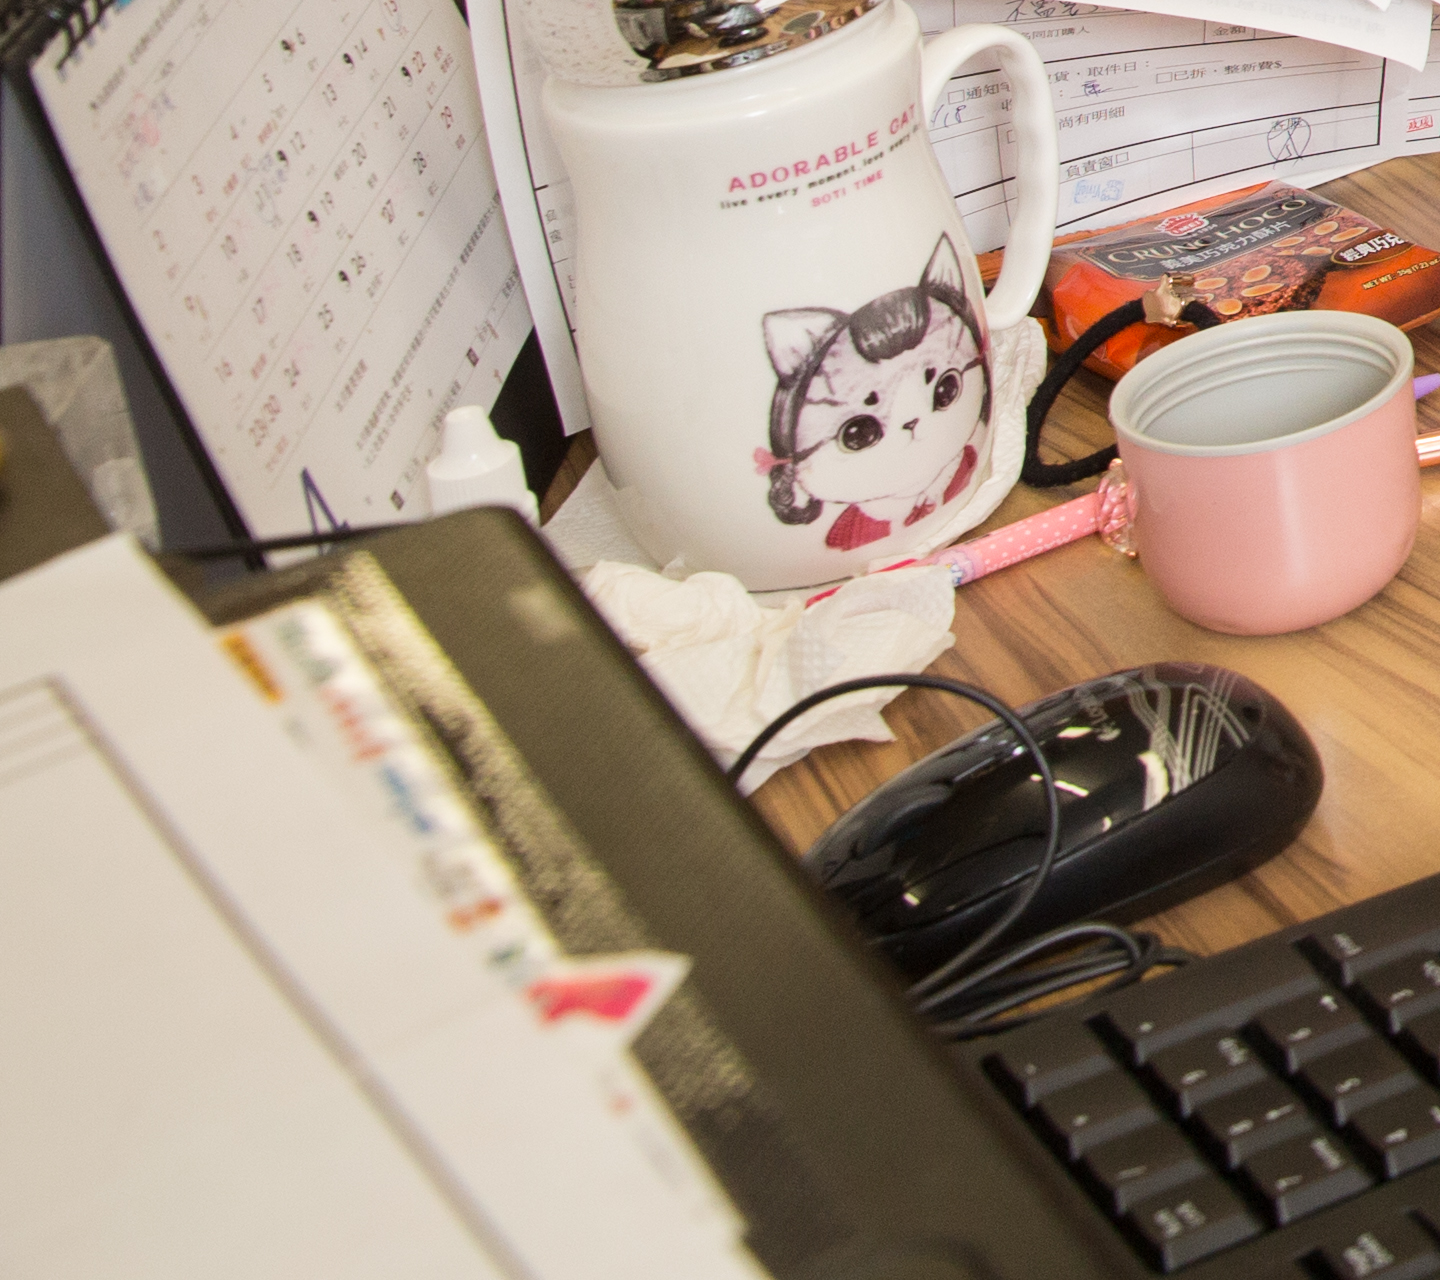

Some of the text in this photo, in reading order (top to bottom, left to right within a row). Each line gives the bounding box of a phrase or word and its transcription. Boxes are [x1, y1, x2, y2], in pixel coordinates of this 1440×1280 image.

[727, 130, 879, 194] ADORABLE
[854, 169, 884, 191] TIME
[719, 198, 748, 210] live
